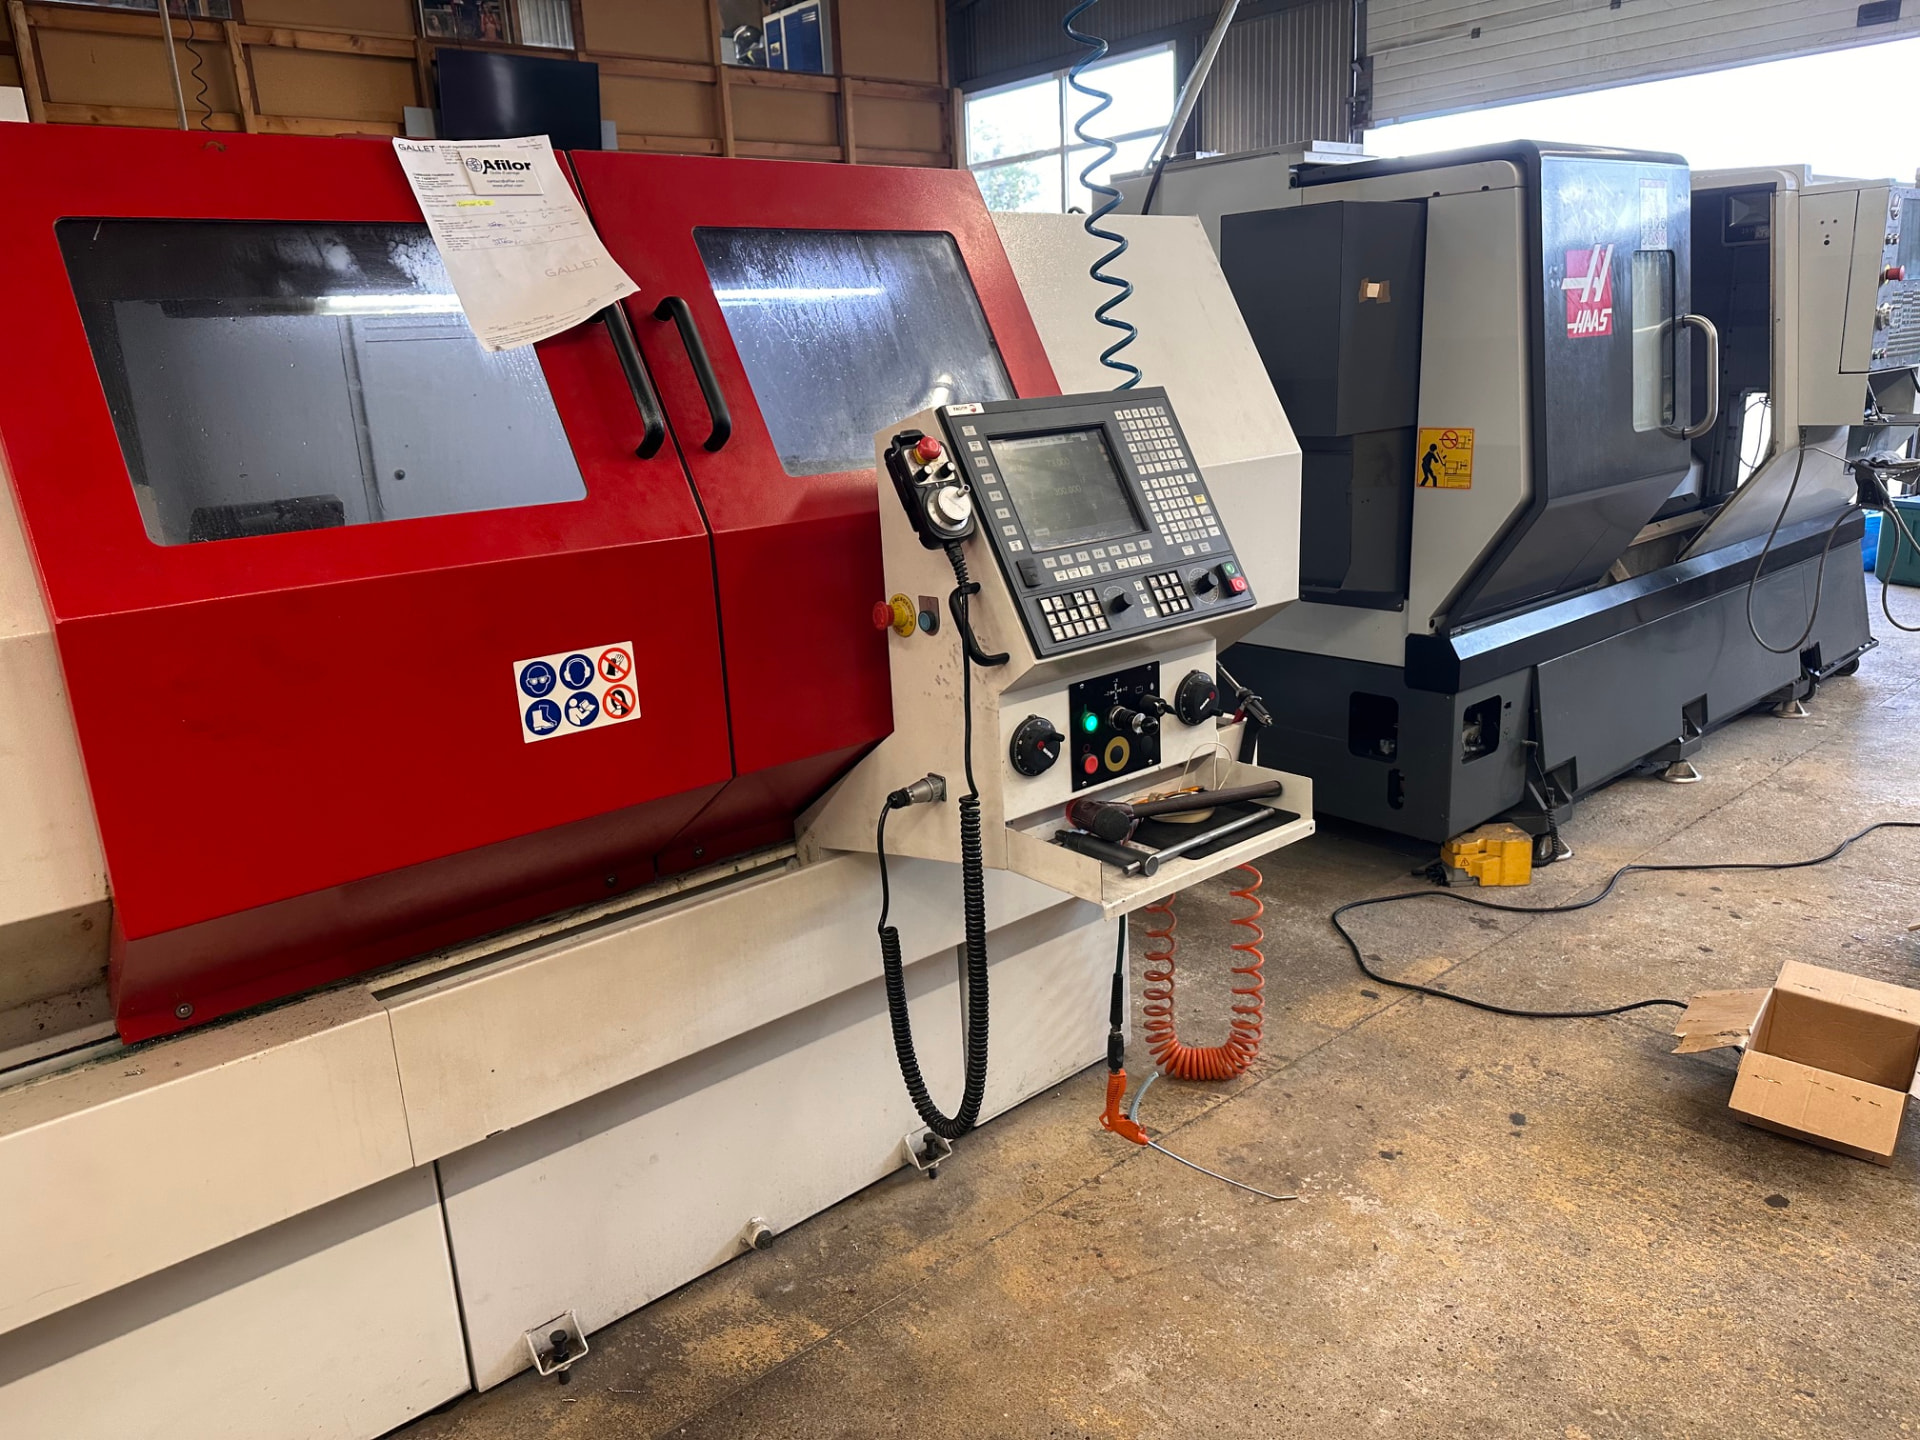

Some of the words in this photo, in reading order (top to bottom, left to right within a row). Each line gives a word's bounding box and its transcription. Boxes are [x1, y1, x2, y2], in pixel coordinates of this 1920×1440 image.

[398, 143, 435, 153] GALLET
[482, 159, 532, 174] Afilor
[545, 257, 600, 278] GALLET
[1567, 308, 1612, 334] HAAS
